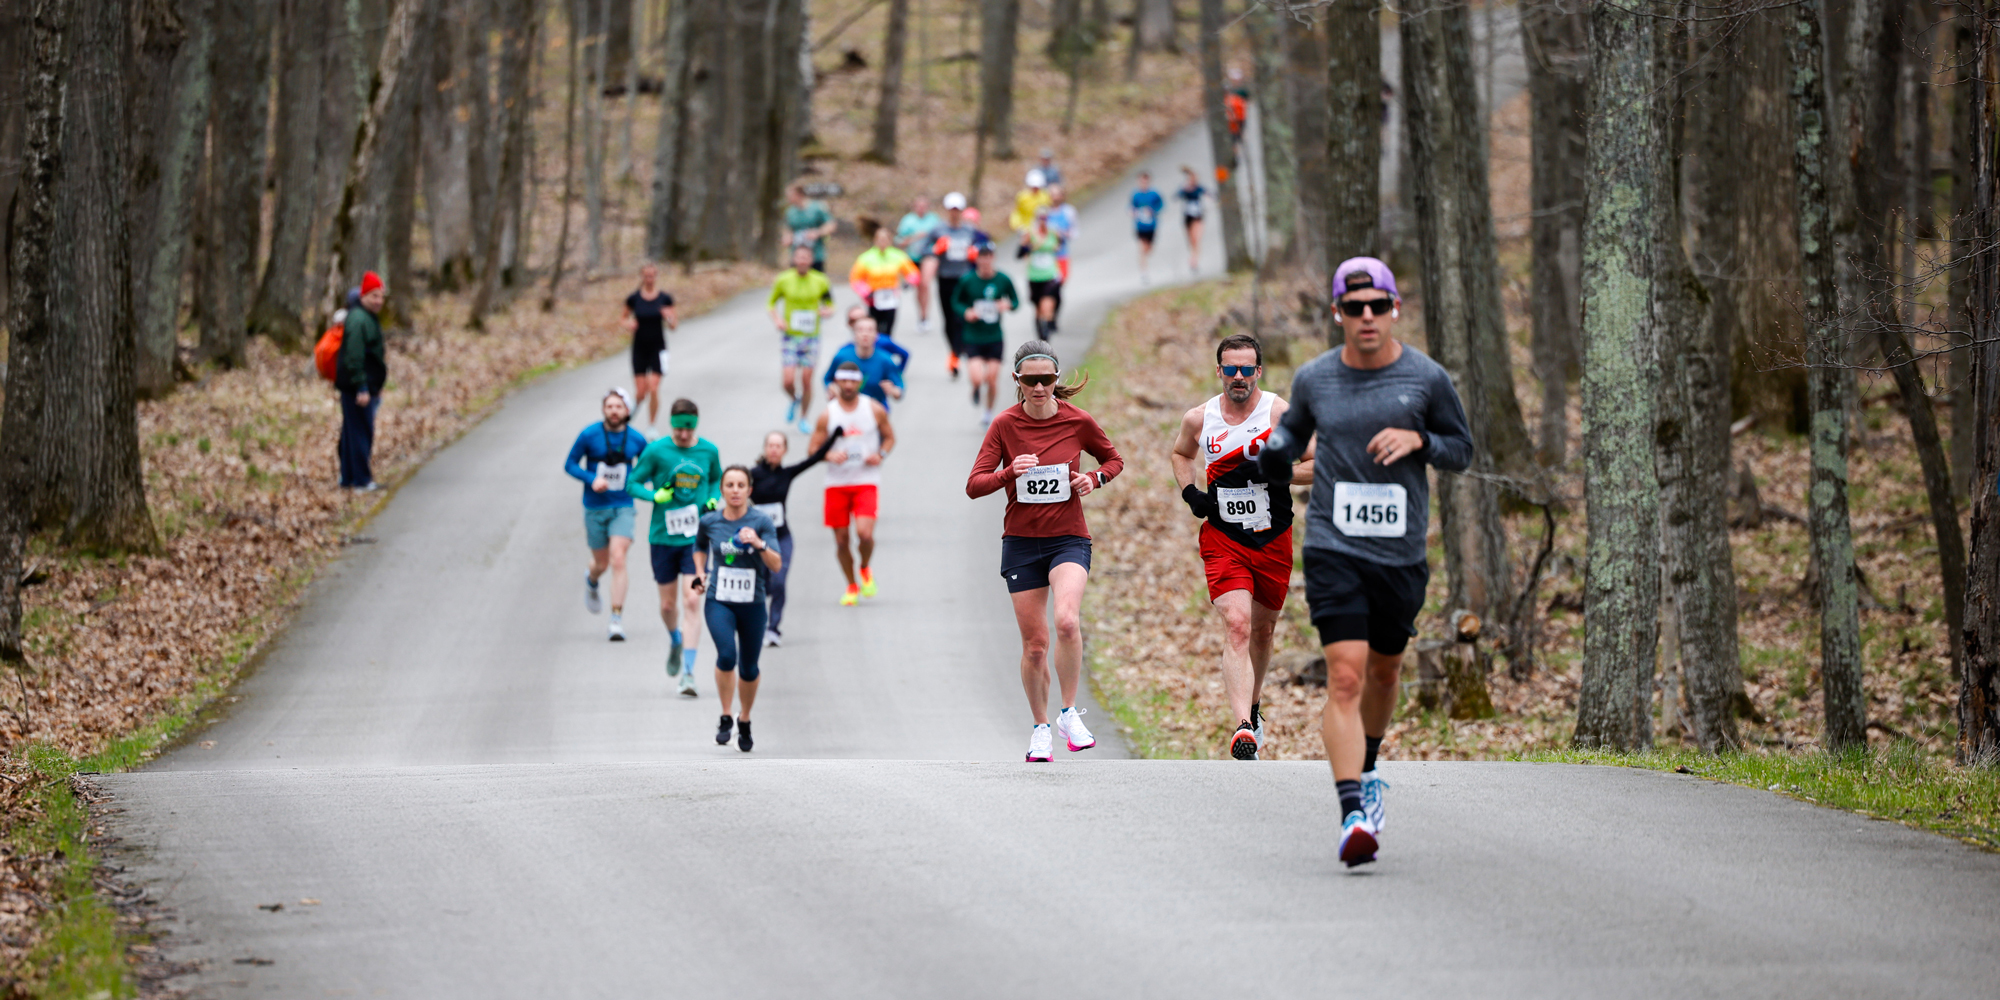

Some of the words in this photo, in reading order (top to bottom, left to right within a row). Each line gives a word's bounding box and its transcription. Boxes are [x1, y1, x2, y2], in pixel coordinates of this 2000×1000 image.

[1027, 479, 1060, 494] 822
[1226, 500, 1257, 516] 890
[1343, 504, 1398, 523] 1456
[723, 578, 751, 590] 1110
